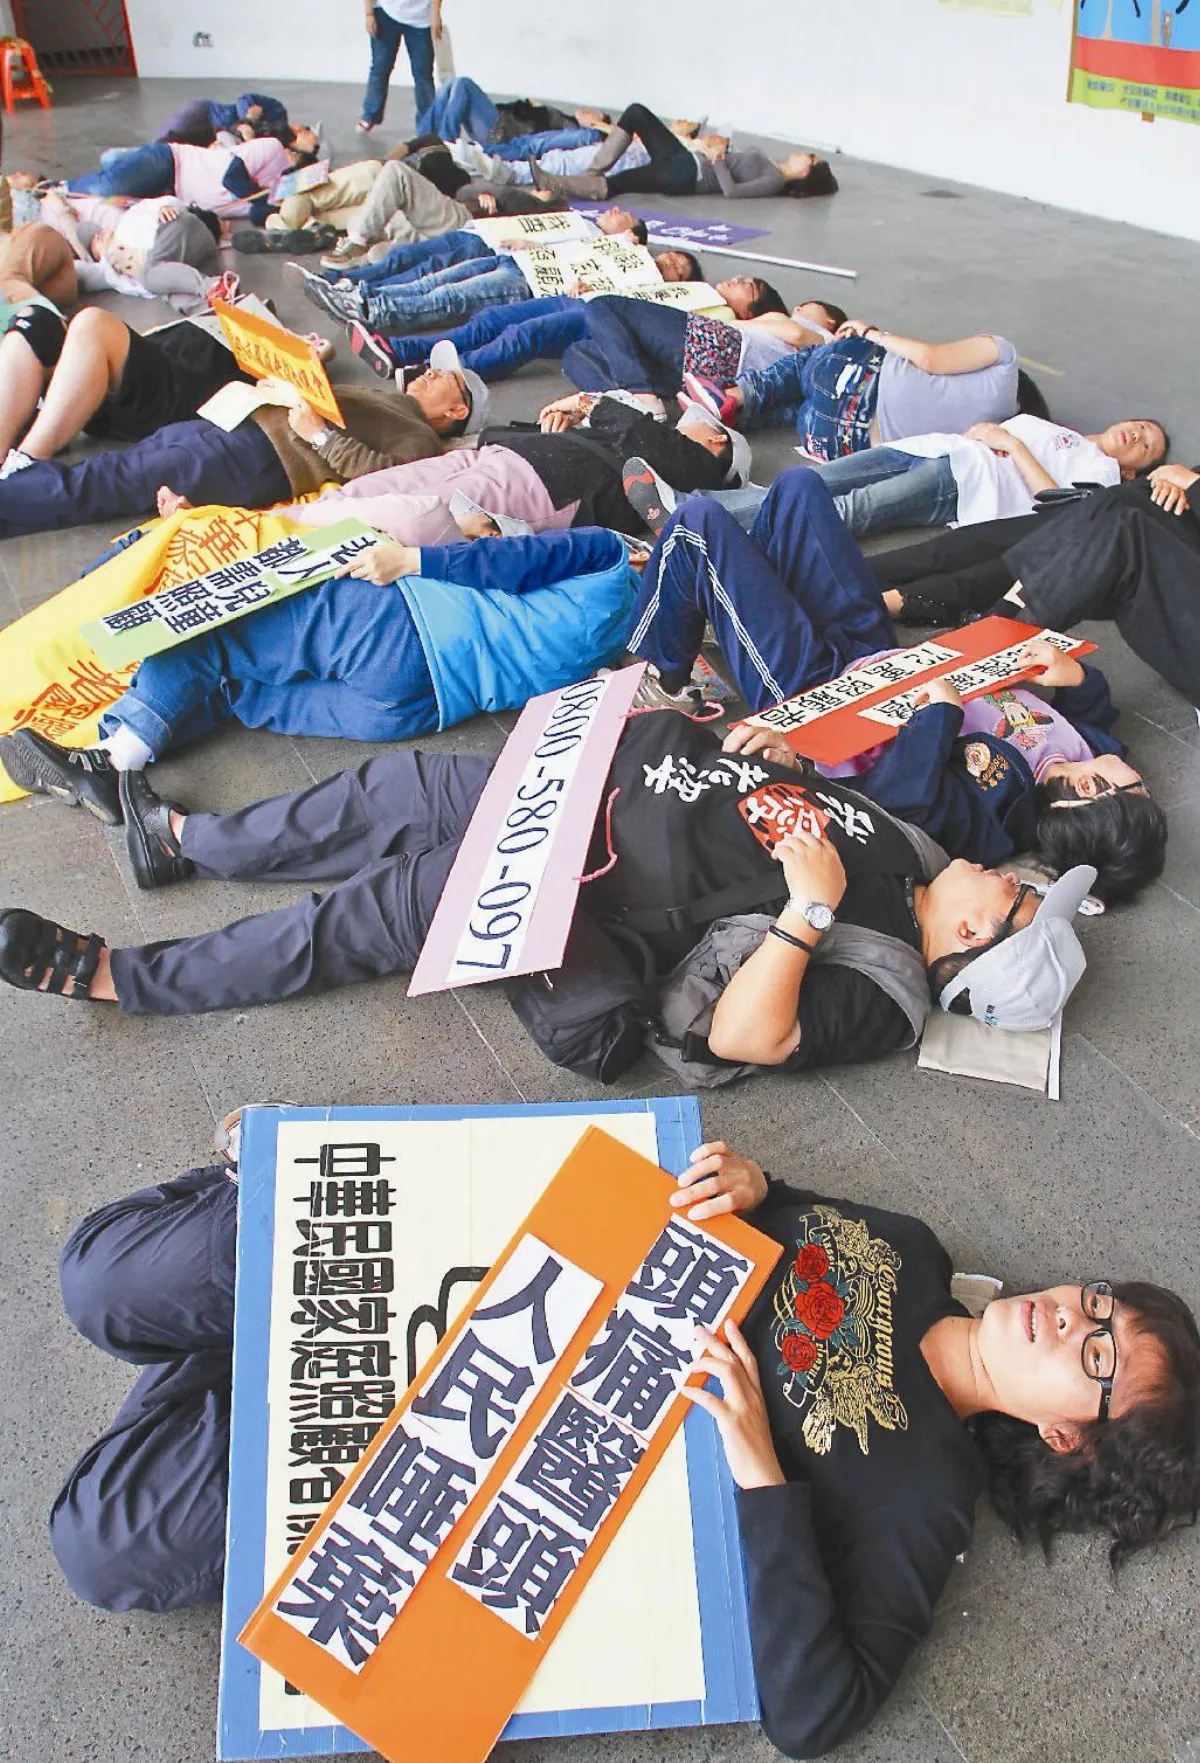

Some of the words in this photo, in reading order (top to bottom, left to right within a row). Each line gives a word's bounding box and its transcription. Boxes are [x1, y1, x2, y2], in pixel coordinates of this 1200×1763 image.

[103, 536, 308, 633] 都需照顧
[456, 678, 606, 971] 0800-580-097
[277, 1255, 564, 1668] 人民唾棄
[449, 1221, 751, 1637] 頭痛醫頭
